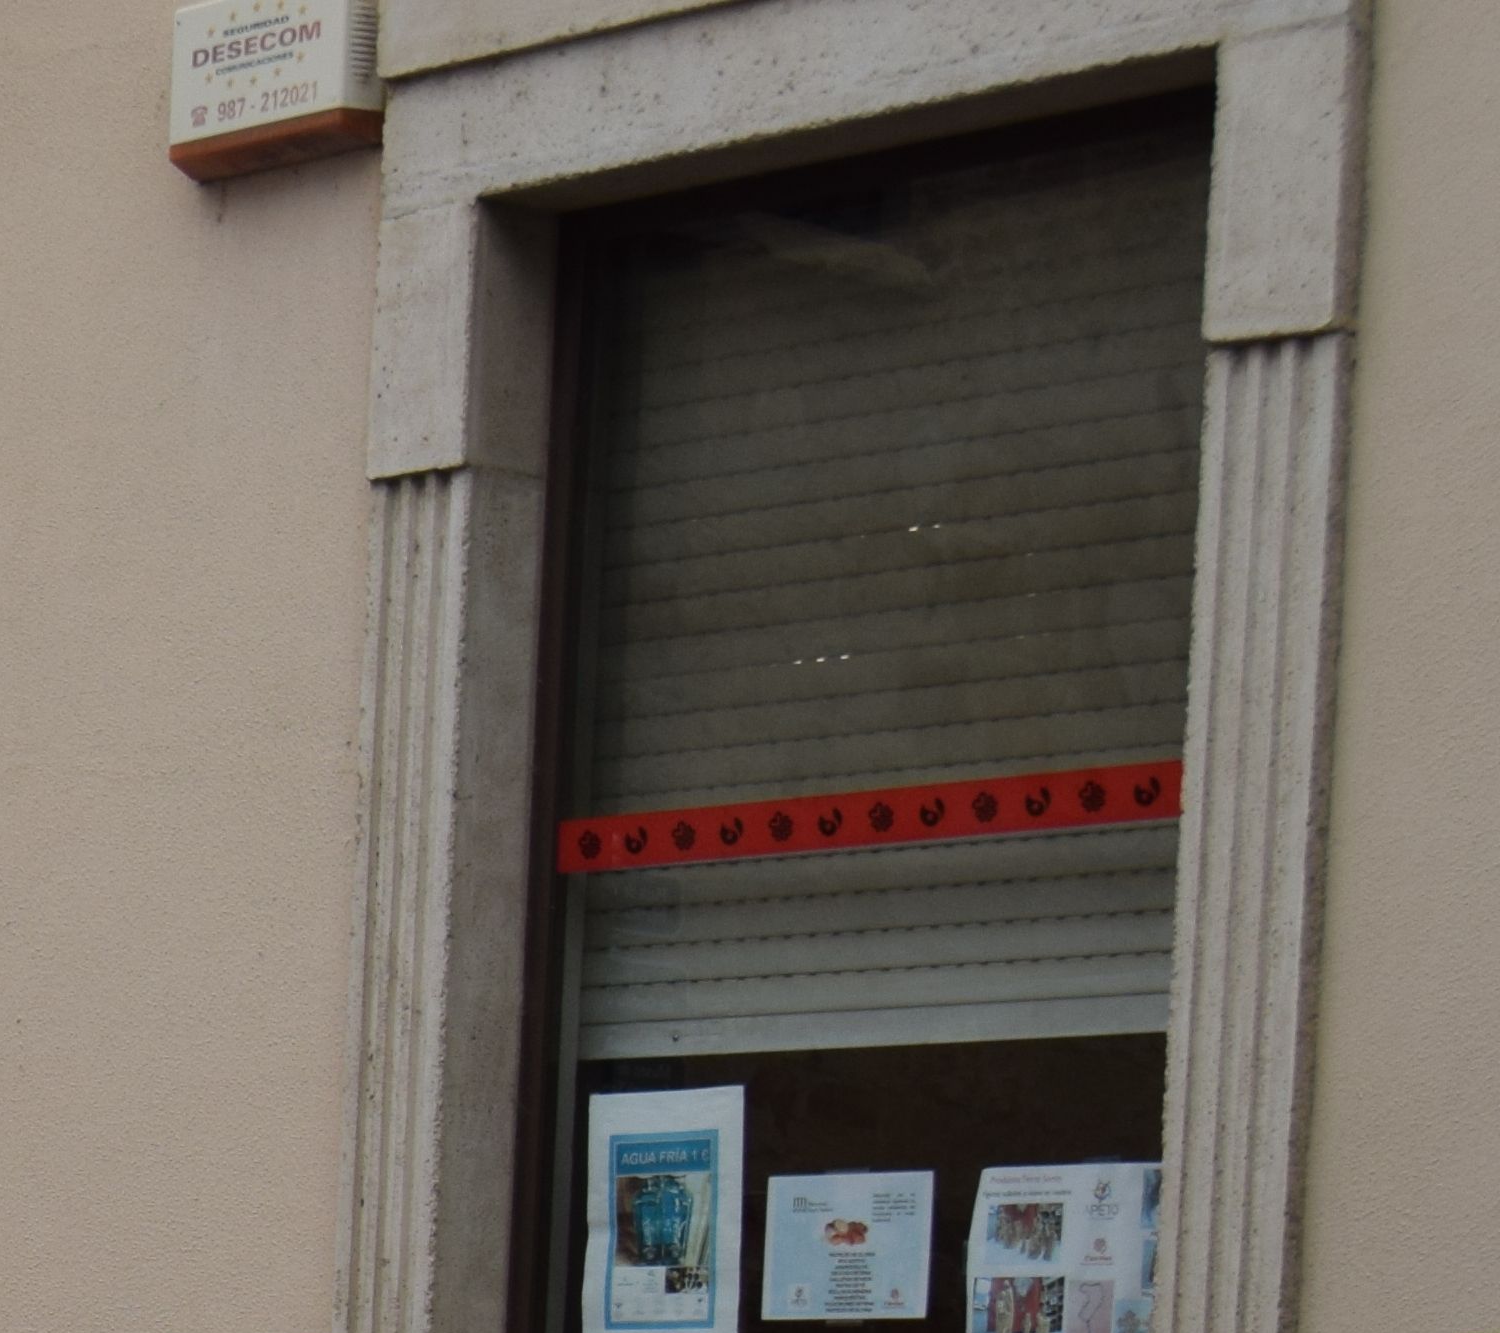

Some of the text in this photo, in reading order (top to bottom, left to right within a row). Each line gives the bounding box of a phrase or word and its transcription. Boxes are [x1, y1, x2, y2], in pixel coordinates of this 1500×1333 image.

[223, 15, 290, 38] SEGURIDAD
[191, 20, 322, 68] DESECOM
[215, 51, 294, 76] COMUNICACIONES
[620, 1151, 656, 1165] AGUA
[659, 1148, 688, 1163] FRÍA
